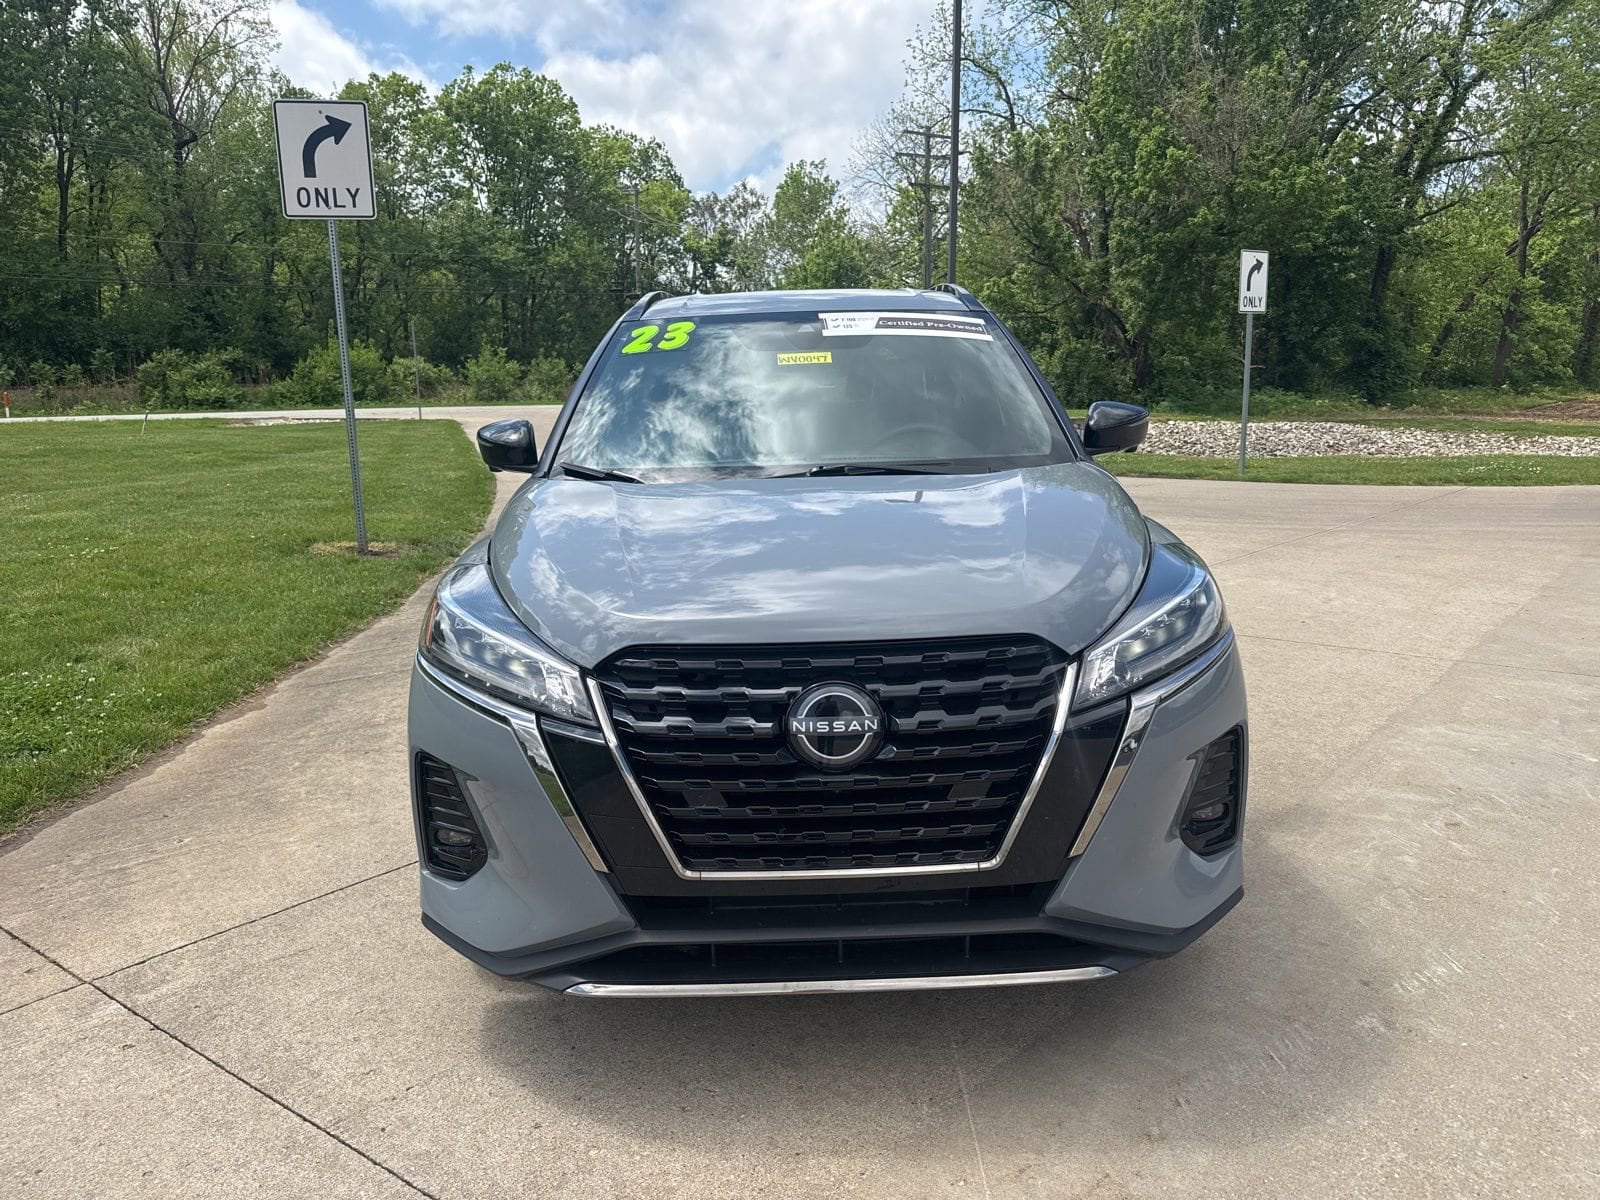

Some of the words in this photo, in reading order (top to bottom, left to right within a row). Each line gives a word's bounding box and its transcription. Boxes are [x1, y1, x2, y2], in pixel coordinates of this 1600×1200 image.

[296, 187, 361, 209] ONLY
[1242, 295, 1263, 309] ONLY
[878, 320, 925, 328] Certified
[926, 320, 984, 333] Pre-Owned
[621, 321, 697, 354] 23
[792, 718, 878, 733] NISSAN
